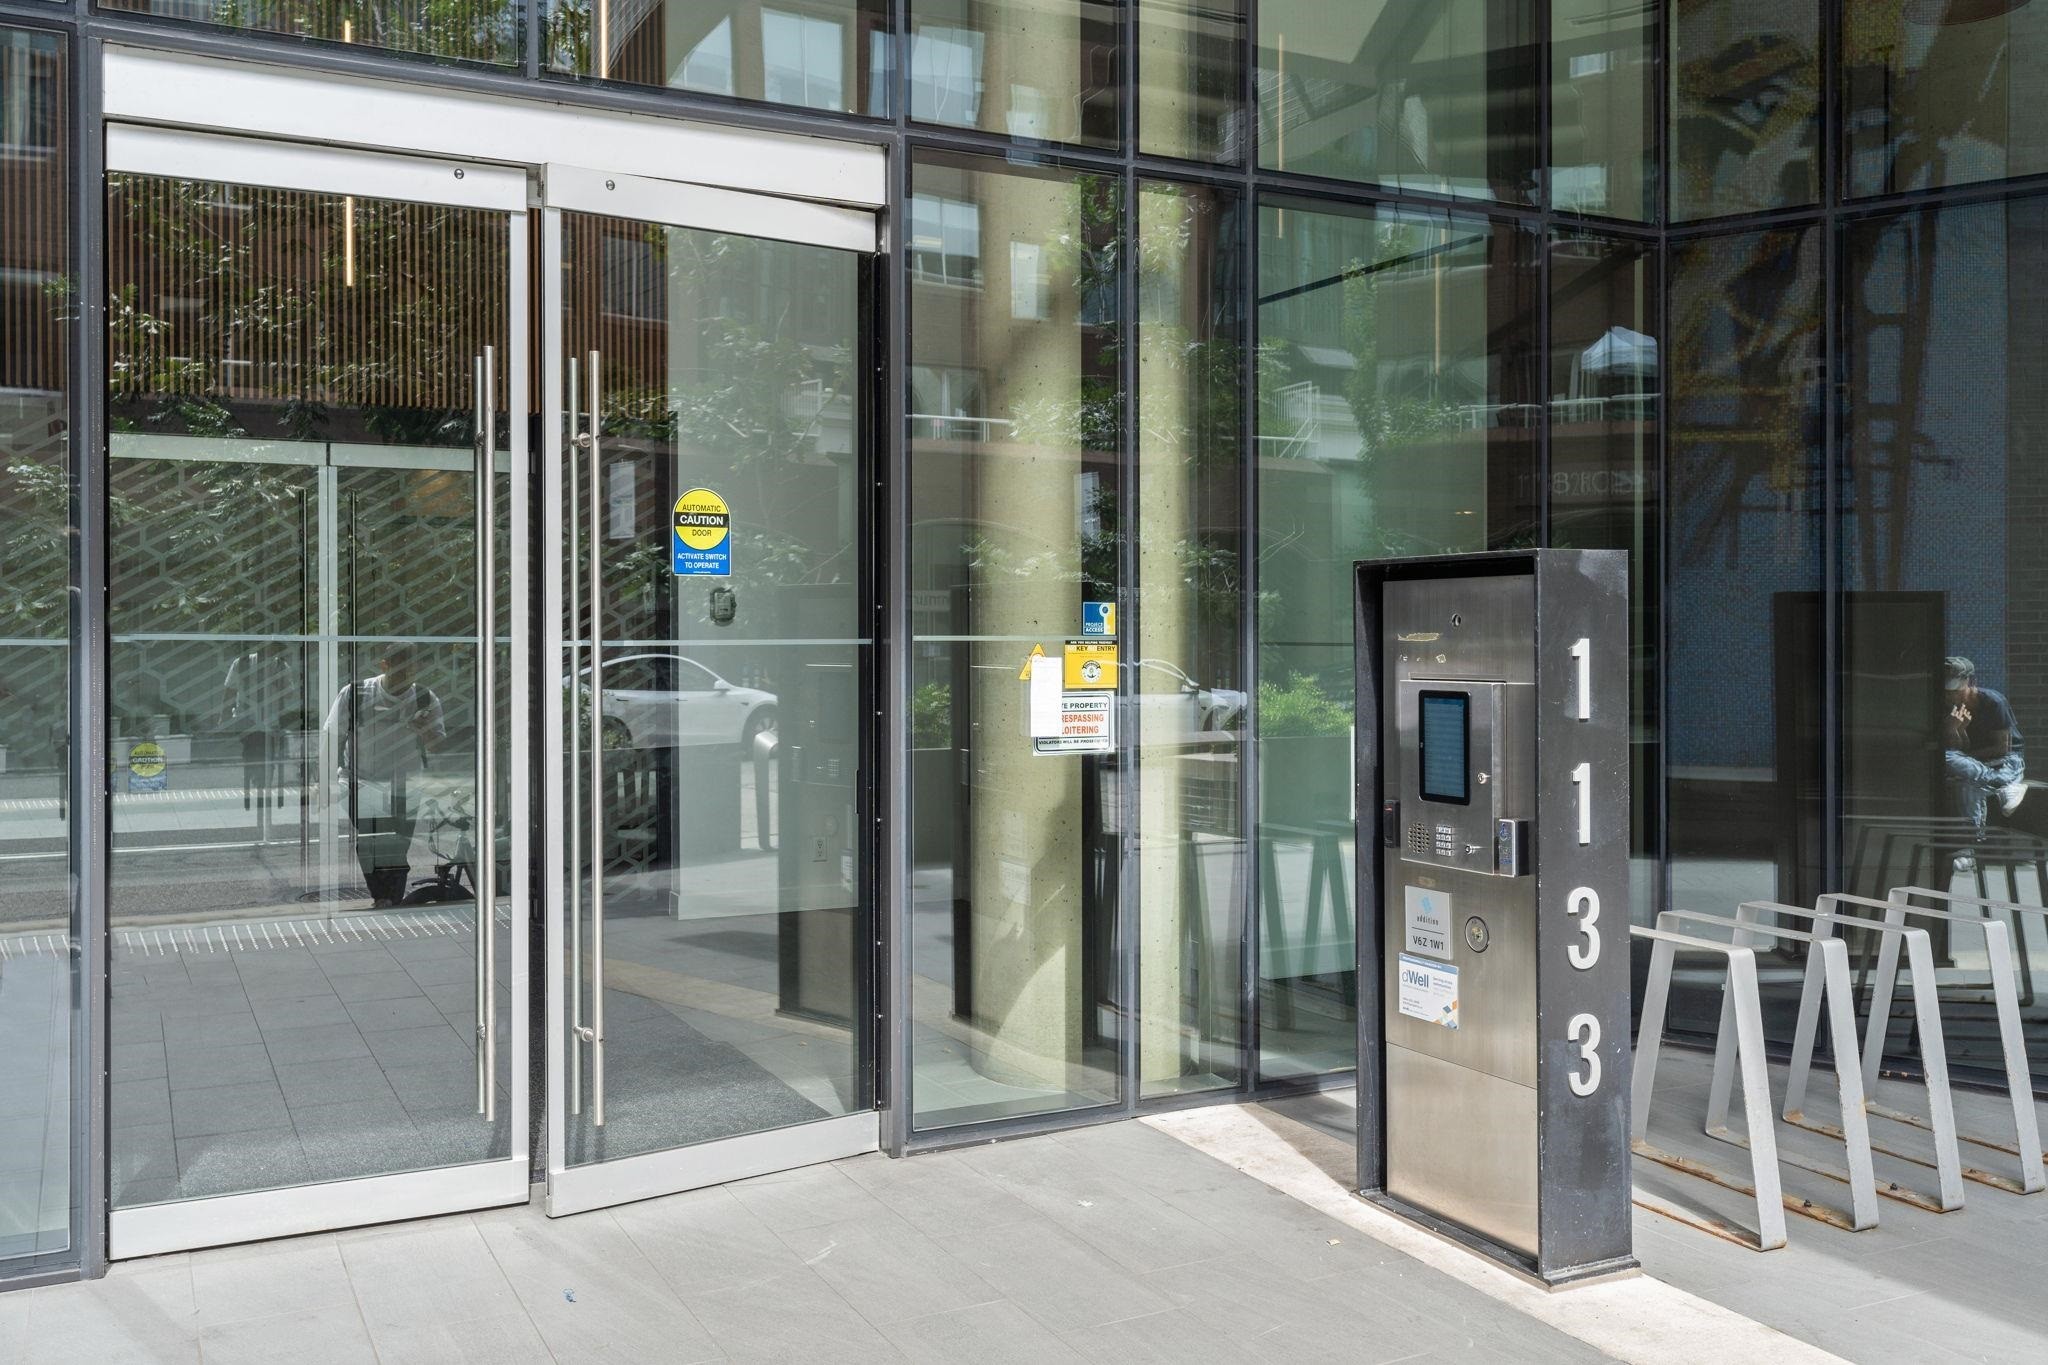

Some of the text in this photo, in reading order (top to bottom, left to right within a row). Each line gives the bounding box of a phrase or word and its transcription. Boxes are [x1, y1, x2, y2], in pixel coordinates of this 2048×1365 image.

[682, 504, 721, 512] AUTOMATIC
[680, 515, 724, 525] CAUTION
[692, 529, 712, 537] DOOR
[1416, 914, 1439, 926] addition
[1412, 935, 1444, 951] V6Z 1W1
